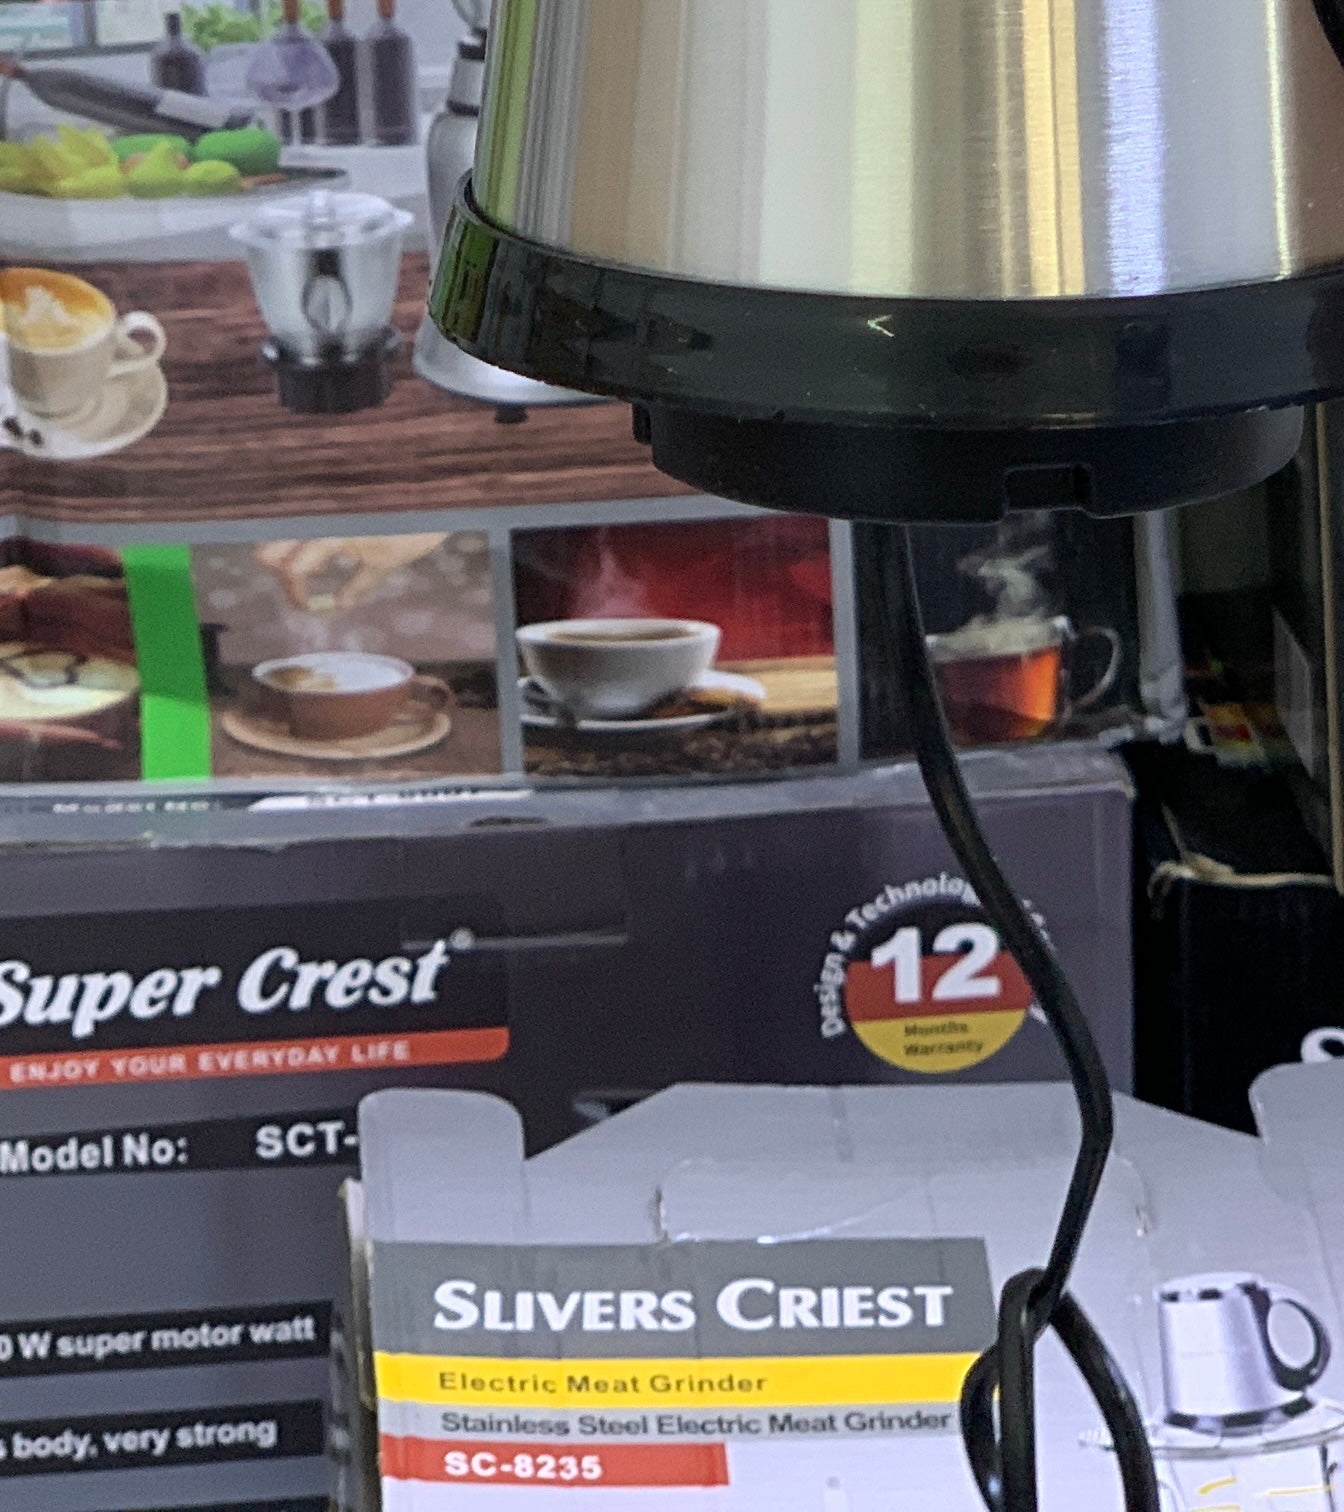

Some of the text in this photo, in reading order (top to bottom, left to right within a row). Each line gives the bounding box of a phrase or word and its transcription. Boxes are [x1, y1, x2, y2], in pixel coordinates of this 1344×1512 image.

[238, 939, 451, 1013] Crest
[871, 921, 1003, 1005] 12
[9, 1040, 412, 1085] ENJOY YOUR EVERYDAY LIFE
[122, 1131, 189, 1166] No:
[433, 1278, 954, 1333] SLIVERS CRIEST
[16, 1330, 52, 1360] W
[57, 1329, 147, 1361] super
[152, 1320, 243, 1350] motor
[249, 1314, 316, 1343] watt
[438, 1370, 768, 1395] Electric Meat Grinder
[12, 1426, 98, 1463] body,
[103, 1423, 171, 1456] very
[175, 1417, 278, 1449] strong
[441, 1408, 953, 1436] Stainless Steel Electric Meat Grinder
[443, 1450, 604, 1481] SC-8235
